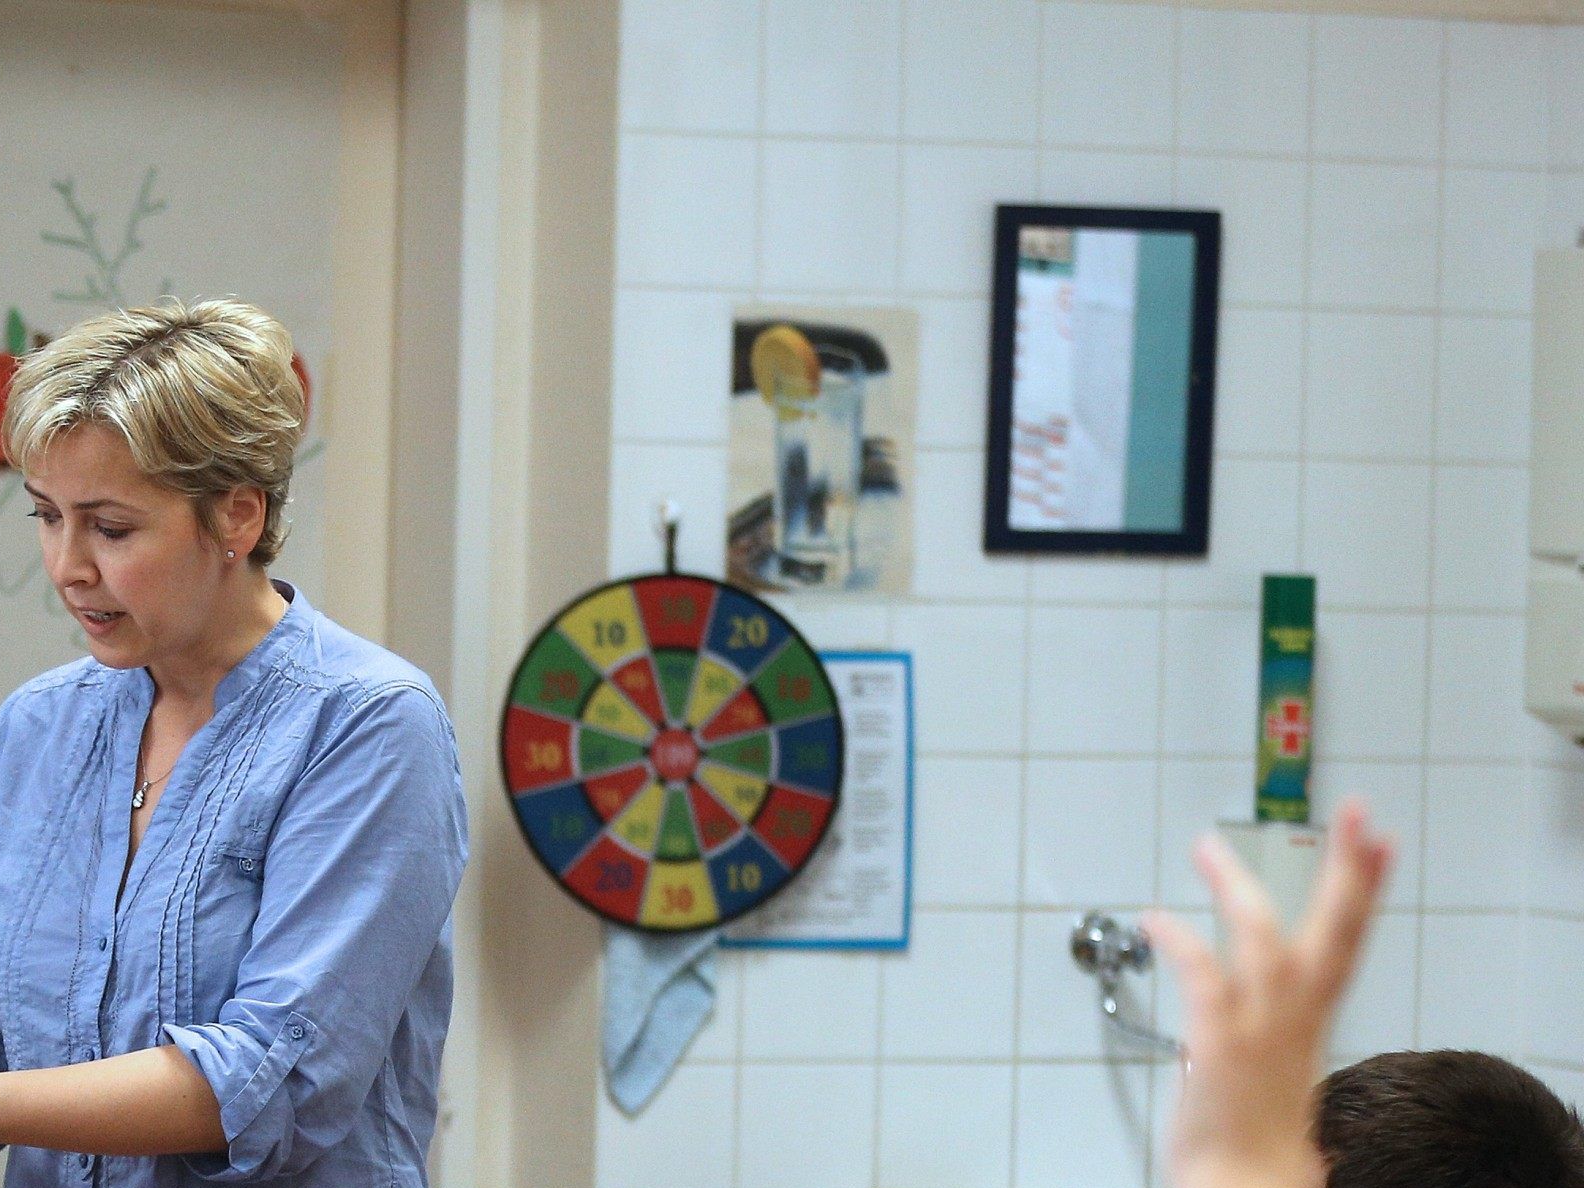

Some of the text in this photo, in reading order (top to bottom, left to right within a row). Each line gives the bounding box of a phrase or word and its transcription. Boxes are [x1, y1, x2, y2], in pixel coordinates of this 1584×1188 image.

[593, 619, 626, 647] 10
[728, 614, 769, 648] 20
[594, 860, 633, 892] 20
[727, 863, 762, 892] 10
